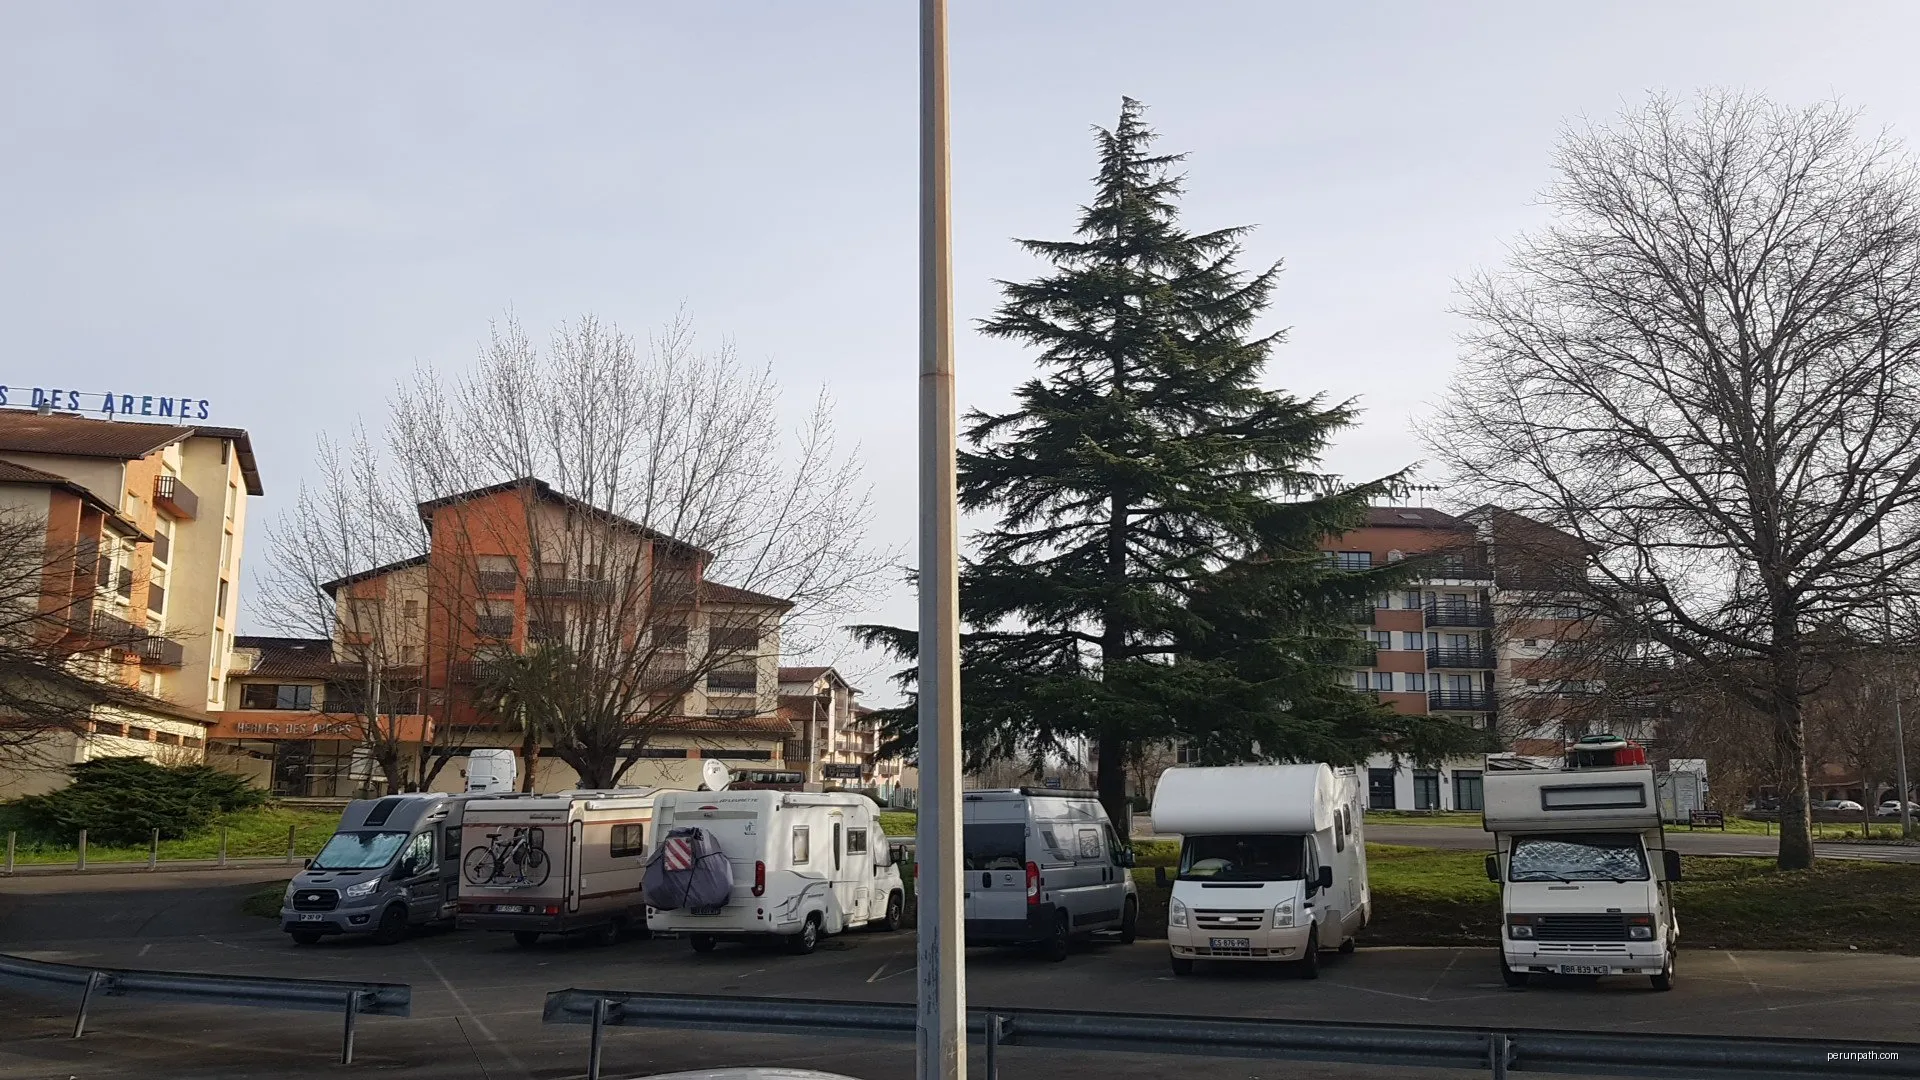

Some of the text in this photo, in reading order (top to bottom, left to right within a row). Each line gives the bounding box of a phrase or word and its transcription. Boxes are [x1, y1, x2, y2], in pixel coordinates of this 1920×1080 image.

[31, 387, 80, 411] DES
[101, 391, 209, 420] ARENES
[285, 723, 306, 734] DES
